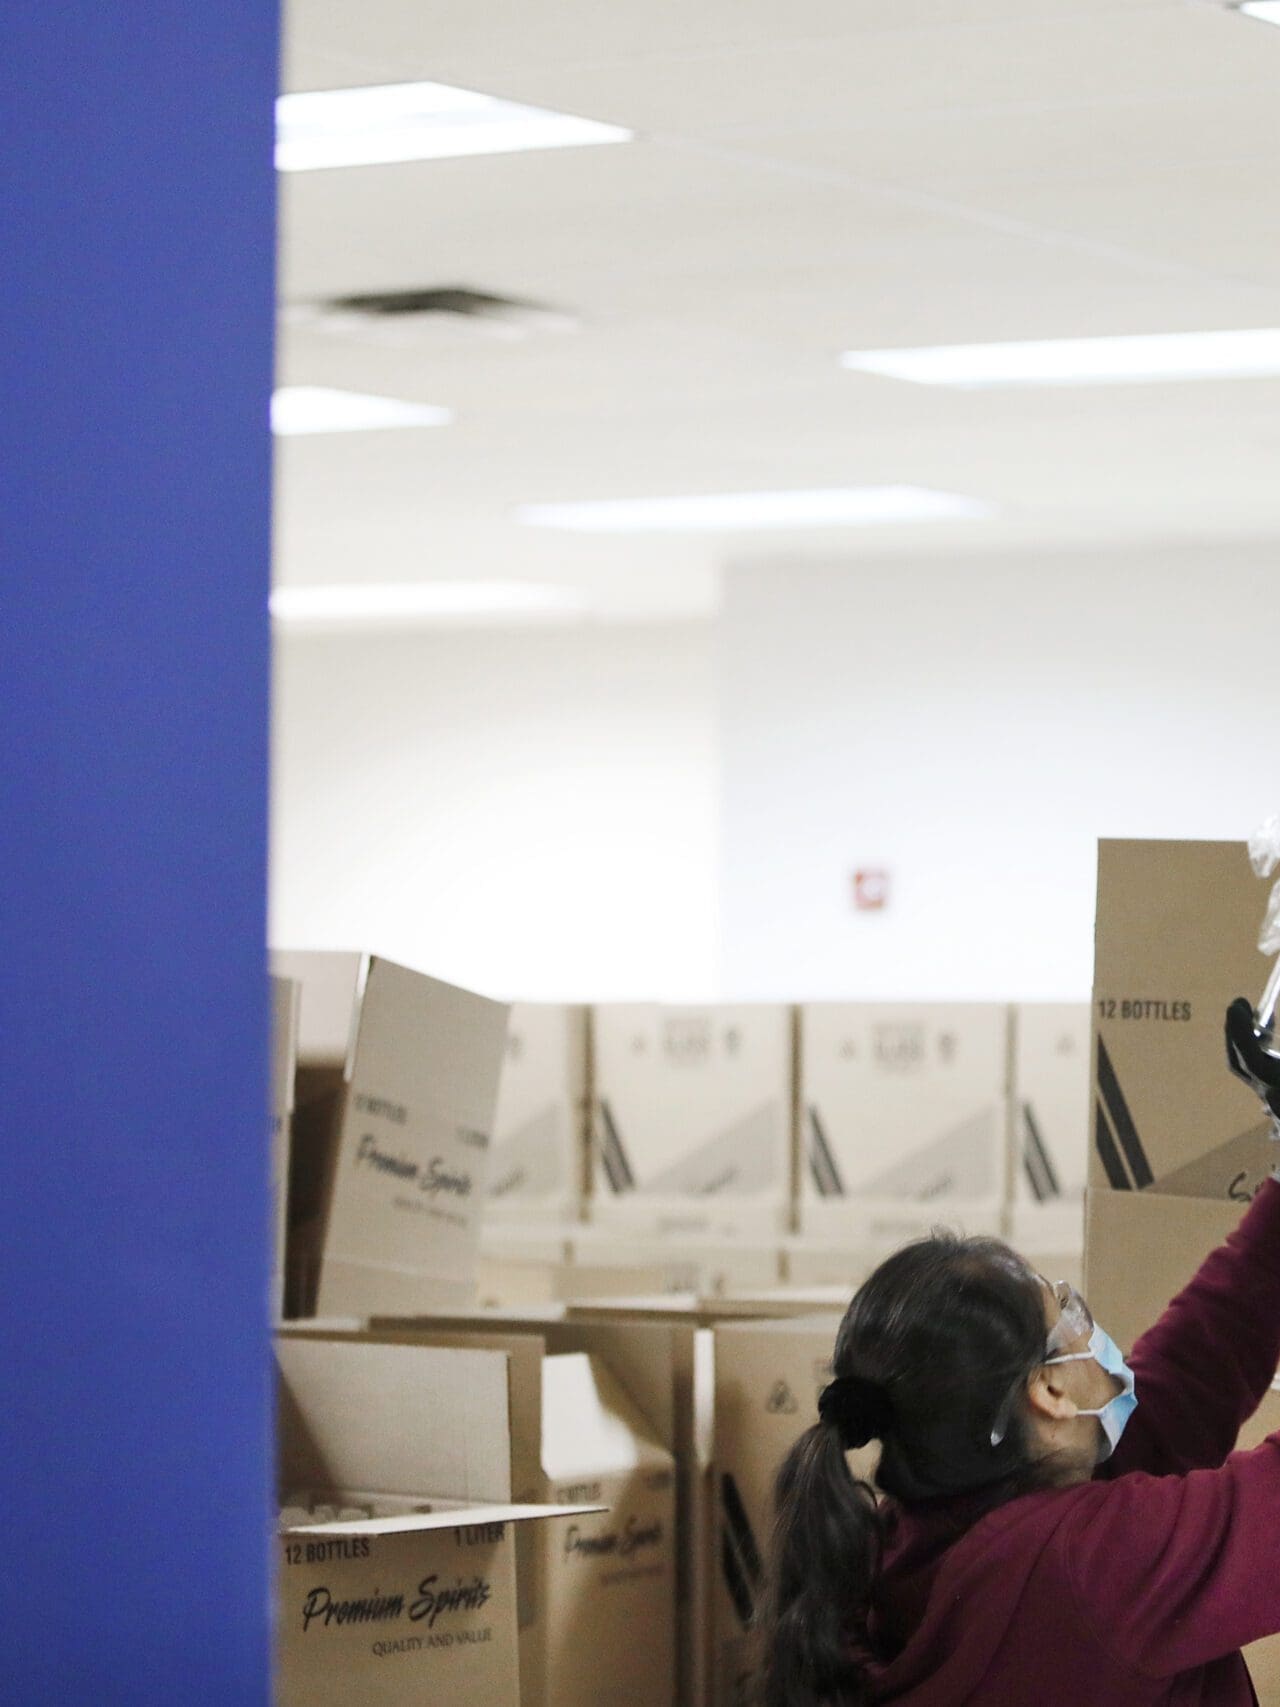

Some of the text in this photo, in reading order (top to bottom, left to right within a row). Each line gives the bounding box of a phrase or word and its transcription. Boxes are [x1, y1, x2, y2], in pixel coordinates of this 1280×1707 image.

[1099, 1000, 1191, 1021] 12 BOTTLES
[286, 1537, 370, 1565] 12 BOTTLES
[303, 1573, 490, 1632] Premium Spirits
[372, 1627, 492, 1658] QUALITY AND VALUE
